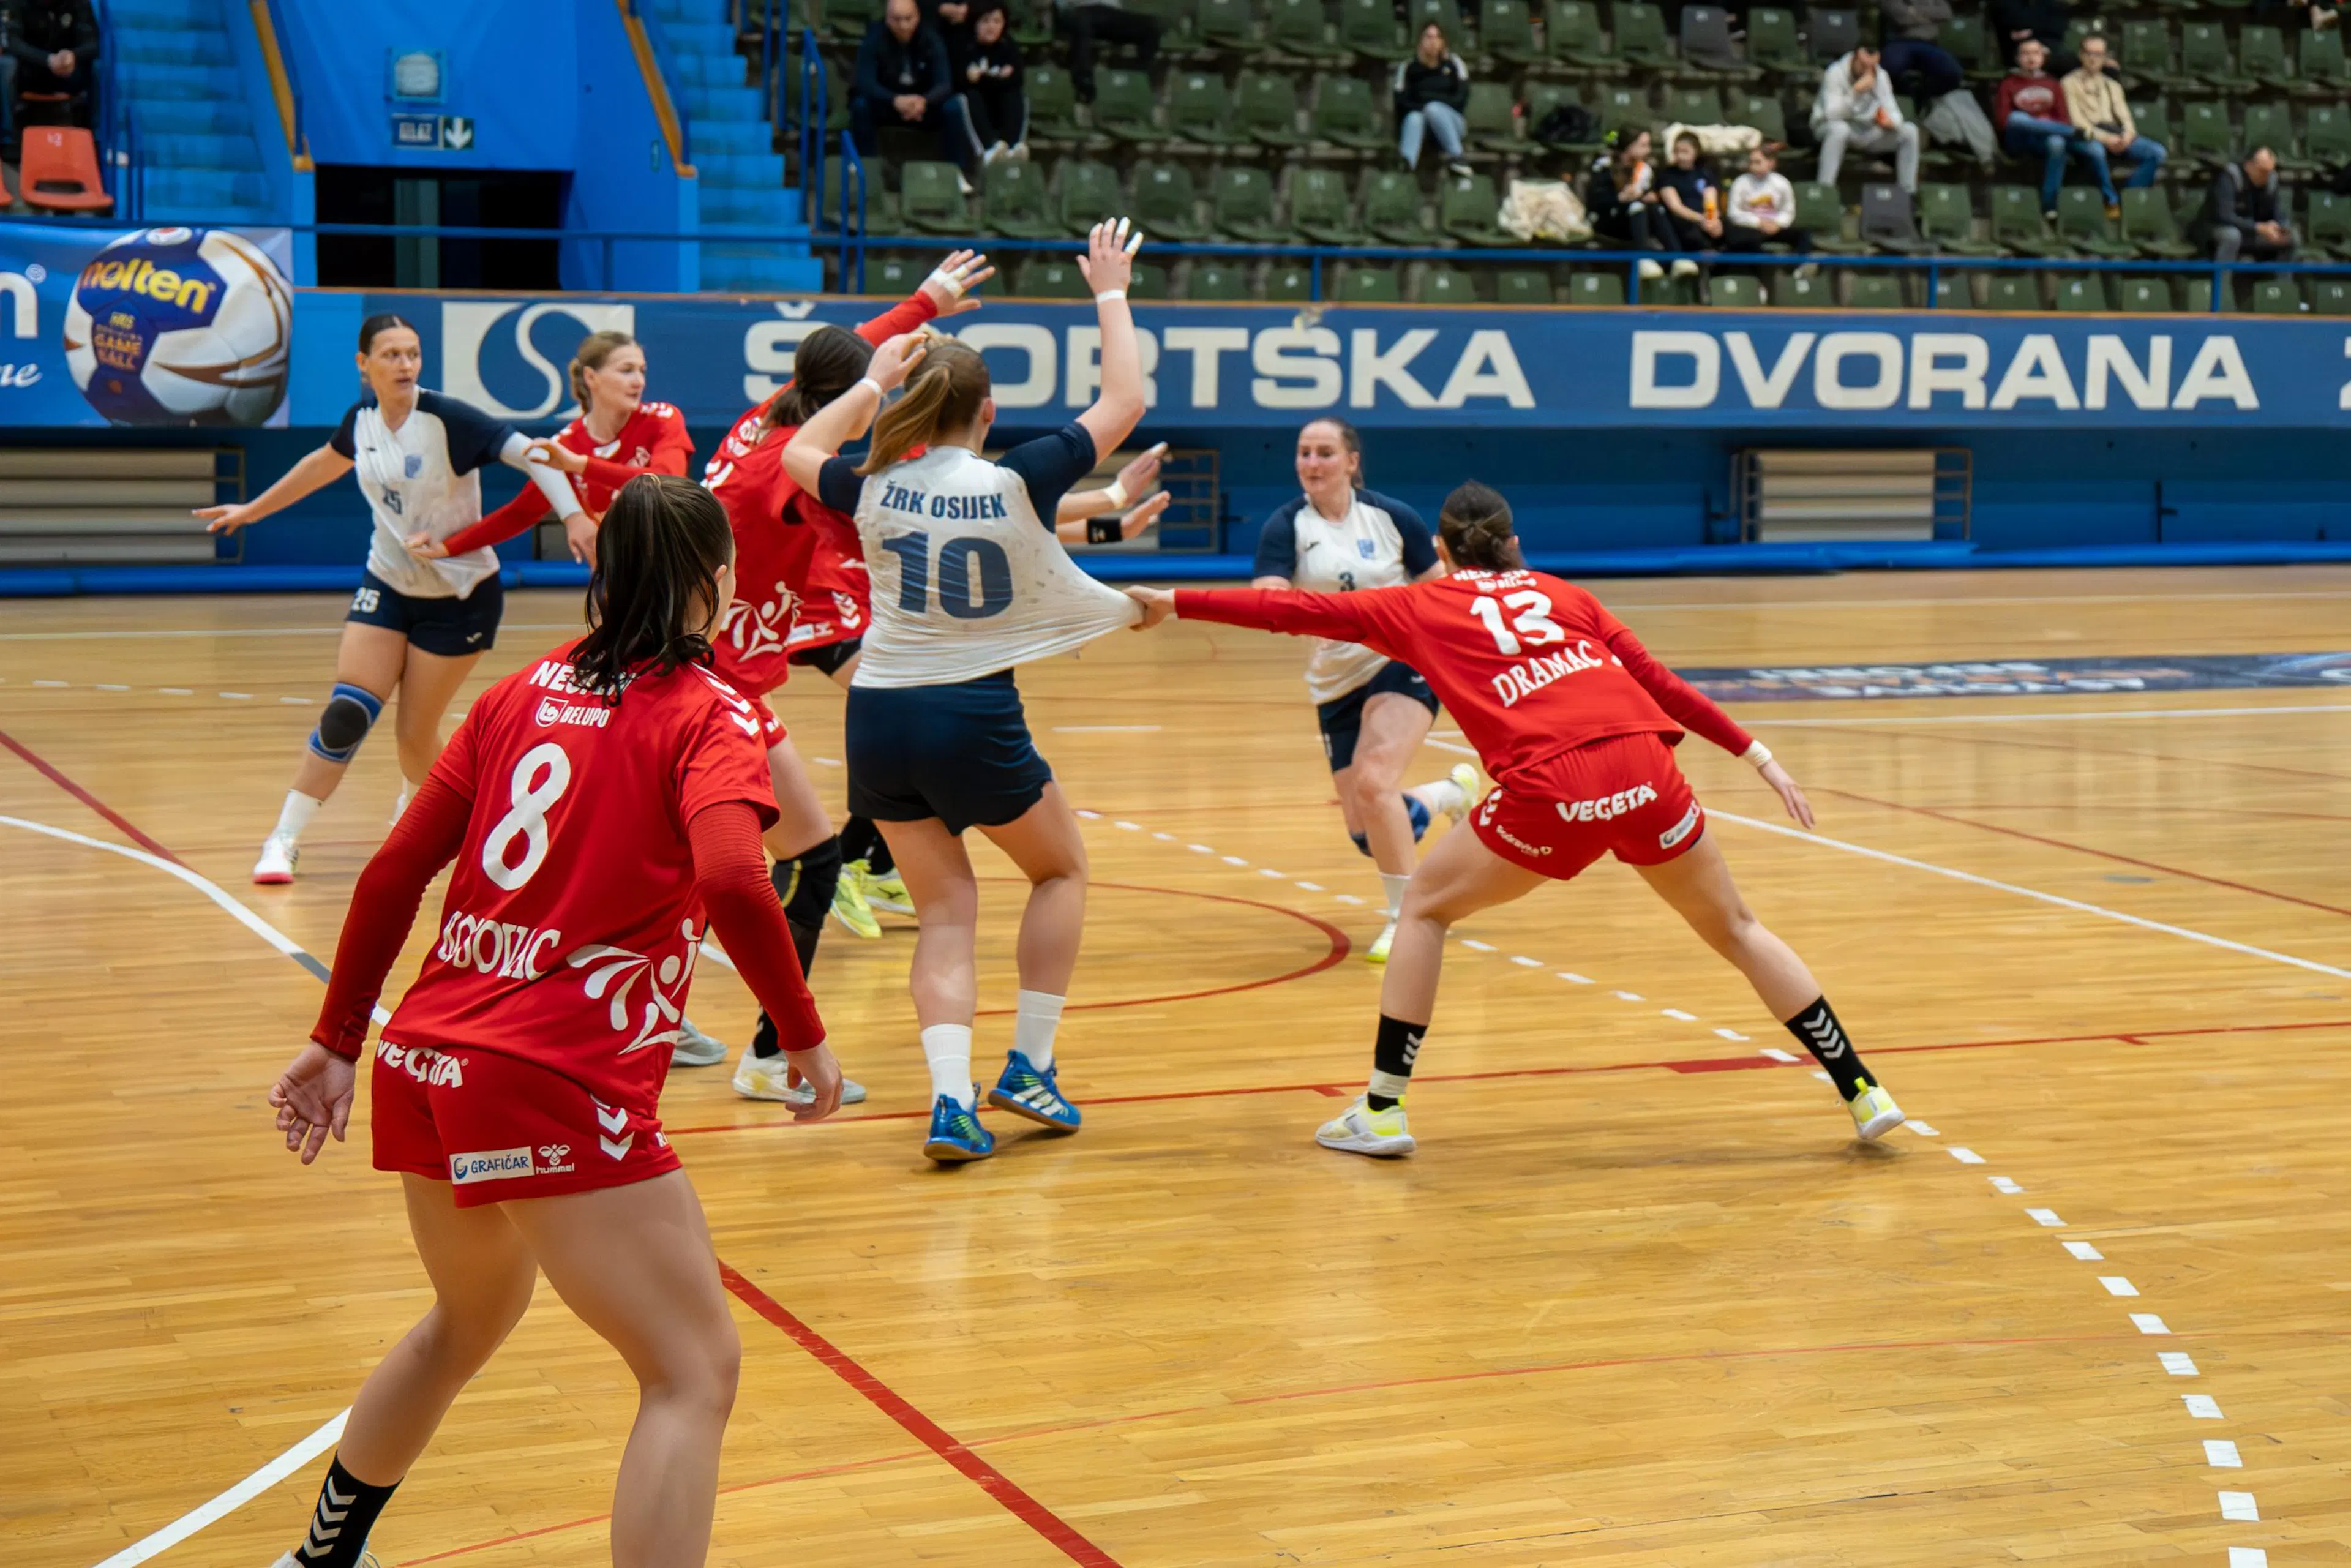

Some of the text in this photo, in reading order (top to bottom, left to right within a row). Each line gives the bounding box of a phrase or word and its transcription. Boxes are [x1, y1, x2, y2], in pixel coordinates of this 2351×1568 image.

[744, 300, 1536, 410] ŠORTSKA
[1629, 331, 2260, 411] DVORANA
[880, 479, 1007, 519] ŽRK OSIJEK
[882, 530, 1013, 620] 10
[351, 587, 381, 613] 25
[1470, 590, 1564, 655] 13
[1491, 639, 1603, 708] DRAMAC
[559, 705, 610, 728] BELUPO
[483, 743, 571, 891] 8
[1555, 784, 1658, 822] VEGETA
[471, 1153, 529, 1174] GRAFIČAR
[536, 1163, 574, 1174] hummel
